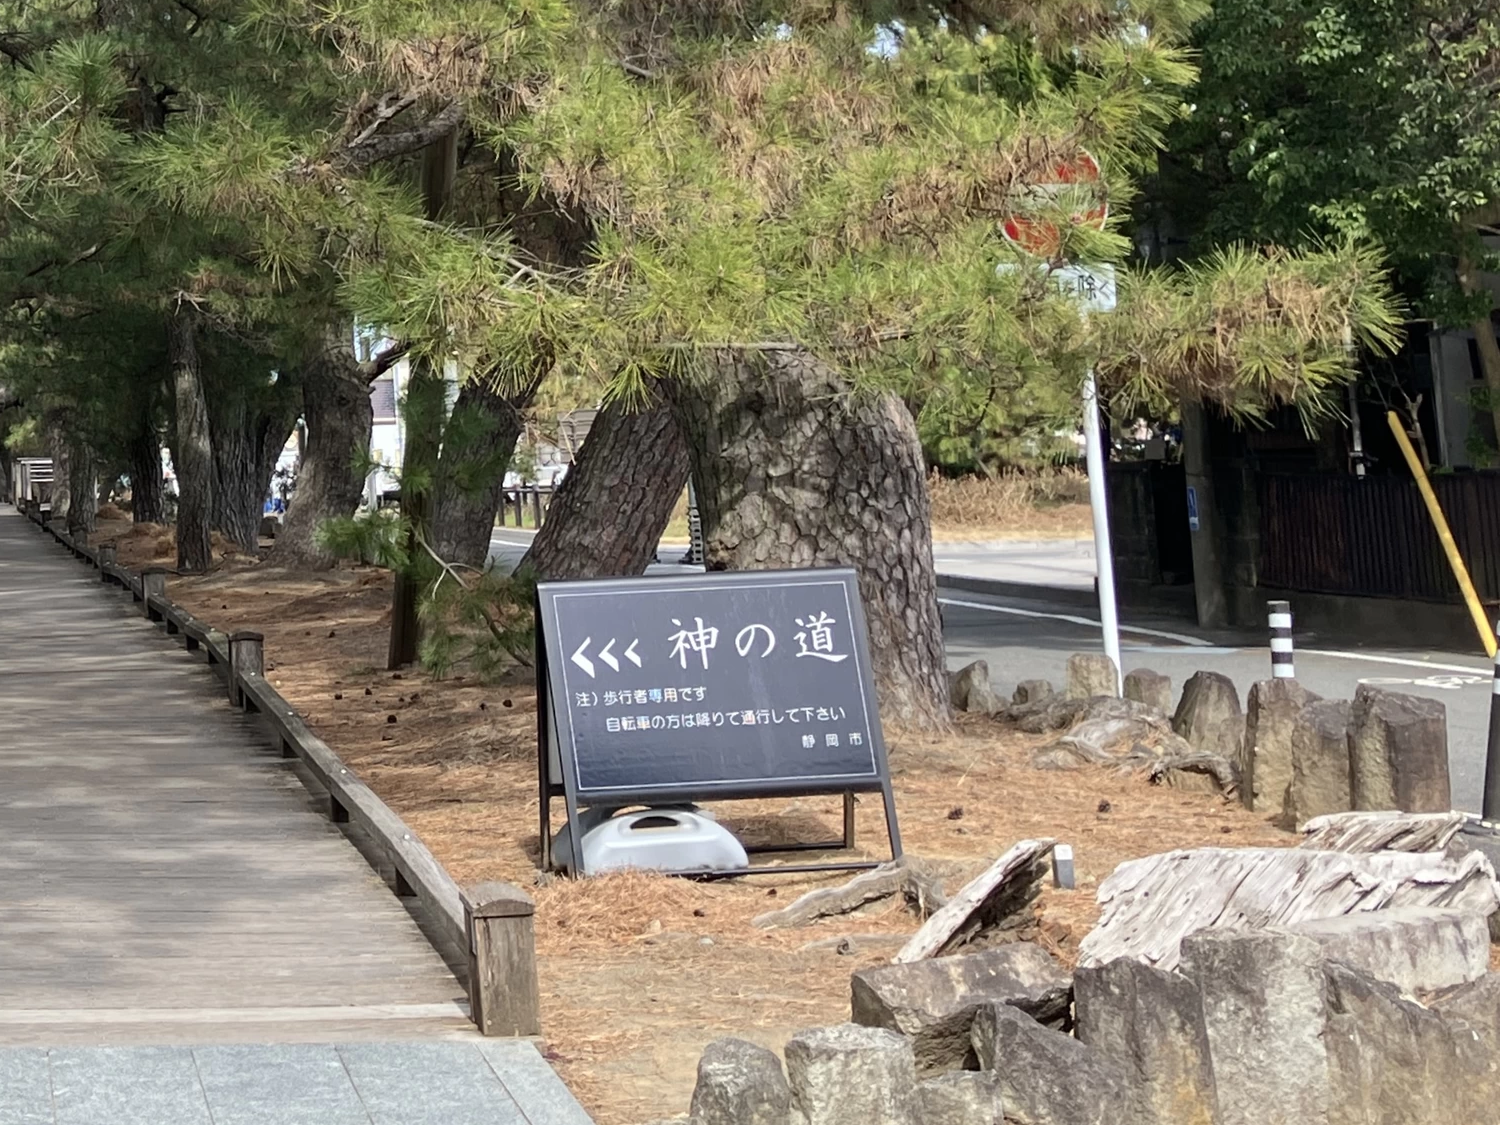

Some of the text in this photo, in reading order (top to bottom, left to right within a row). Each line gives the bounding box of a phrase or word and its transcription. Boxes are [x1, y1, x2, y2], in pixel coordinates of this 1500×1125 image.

[667, 611, 849, 670] 神の道
[606, 706, 847, 733] 自転車の方は降りて通行して下さい
